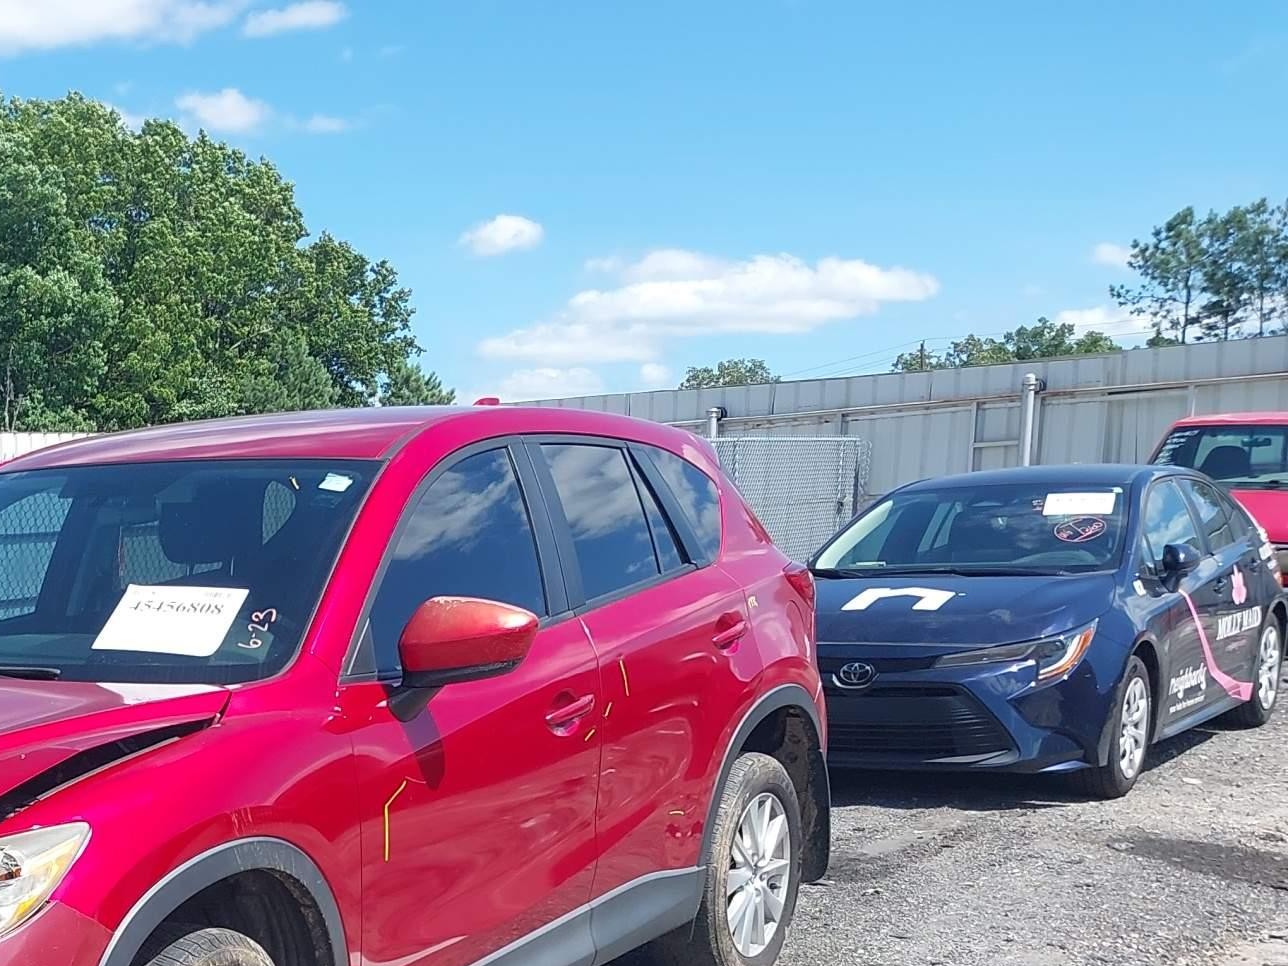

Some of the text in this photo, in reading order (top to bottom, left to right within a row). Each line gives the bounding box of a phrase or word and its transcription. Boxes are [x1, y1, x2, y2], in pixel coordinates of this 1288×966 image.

[129, 599, 225, 615] 45456808
[1216, 606, 1262, 640] MOLLY MAID
[238, 608, 277, 650] 6-23
